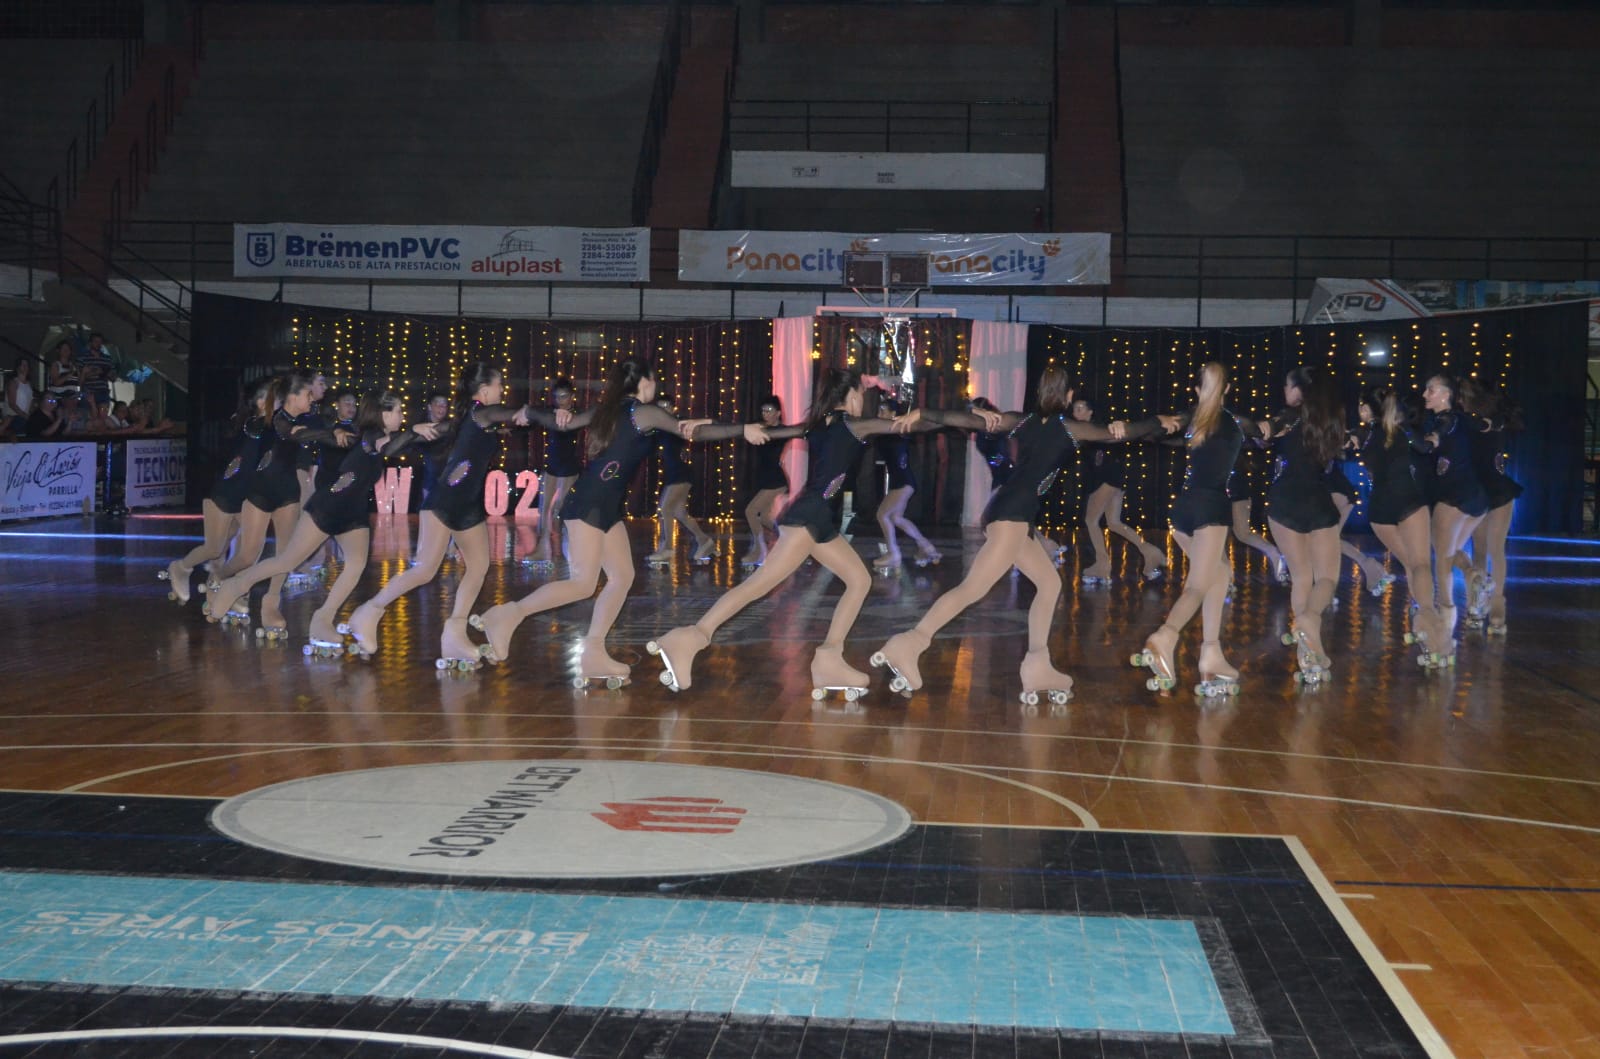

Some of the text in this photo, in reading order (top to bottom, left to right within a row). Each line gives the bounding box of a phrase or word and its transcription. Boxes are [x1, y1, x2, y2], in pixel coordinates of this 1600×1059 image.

[285, 232, 460, 259] BrëmenPVC
[285, 258, 461, 271] ABERTURAS DE ALTA PRESTACION
[471, 256, 563, 276] aluplast
[930, 248, 1046, 281] anacity
[48, 484, 78, 496] PARRILLA
[484, 469, 560, 517] 02
[408, 766, 581, 859] BETWARRIOR
[26, 910, 590, 947] BUENOS AIRES
